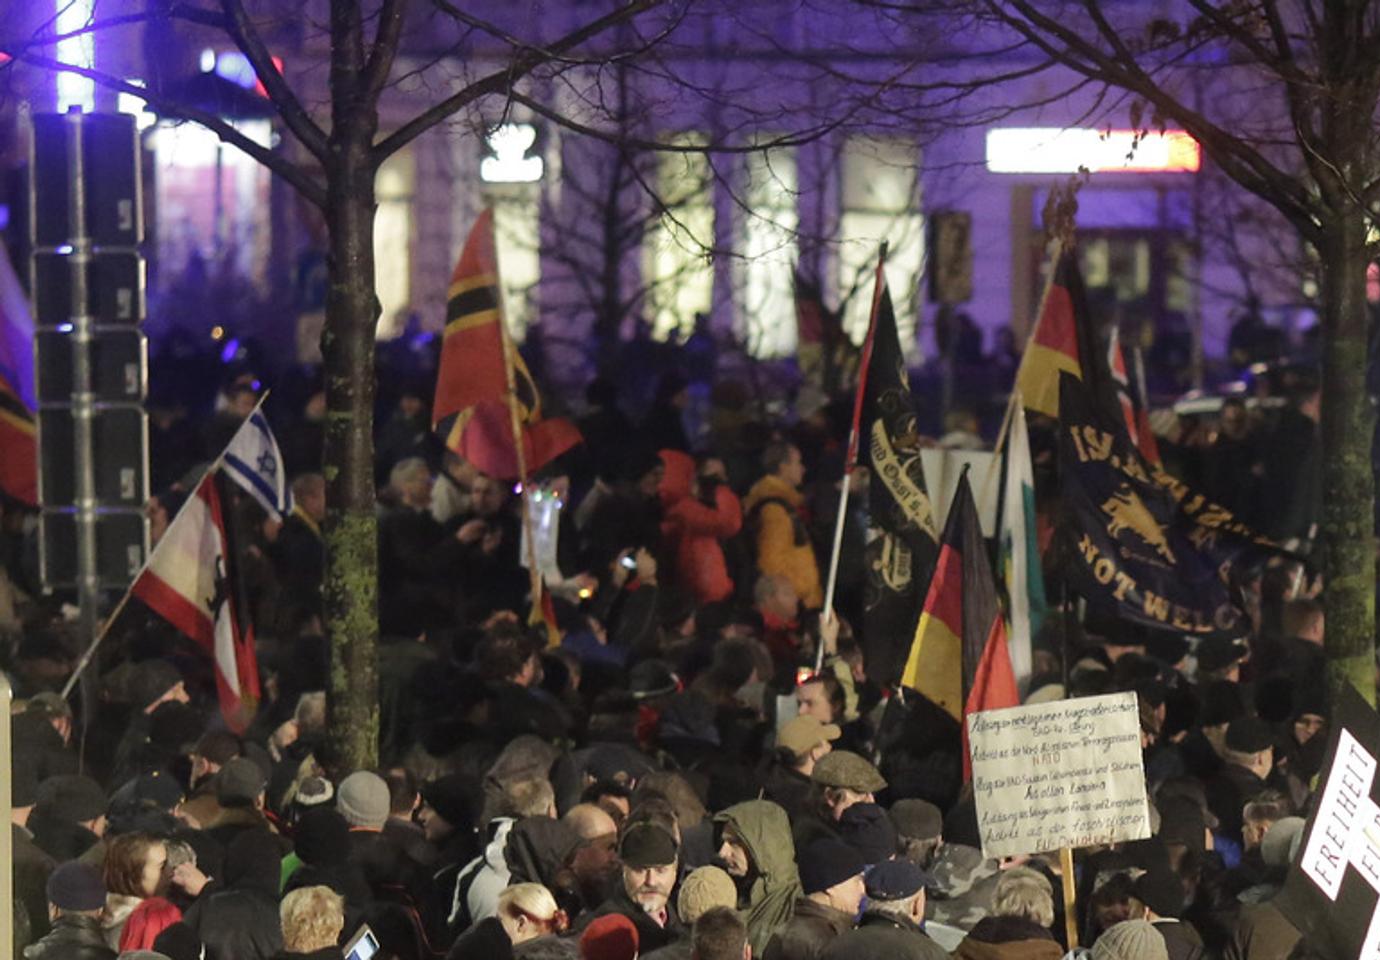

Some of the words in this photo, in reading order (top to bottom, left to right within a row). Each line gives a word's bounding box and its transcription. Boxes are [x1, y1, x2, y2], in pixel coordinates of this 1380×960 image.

[1078, 533, 1137, 601] NOT
[1032, 753, 1061, 766] NATO
[1314, 744, 1370, 886] FREIHEIT
